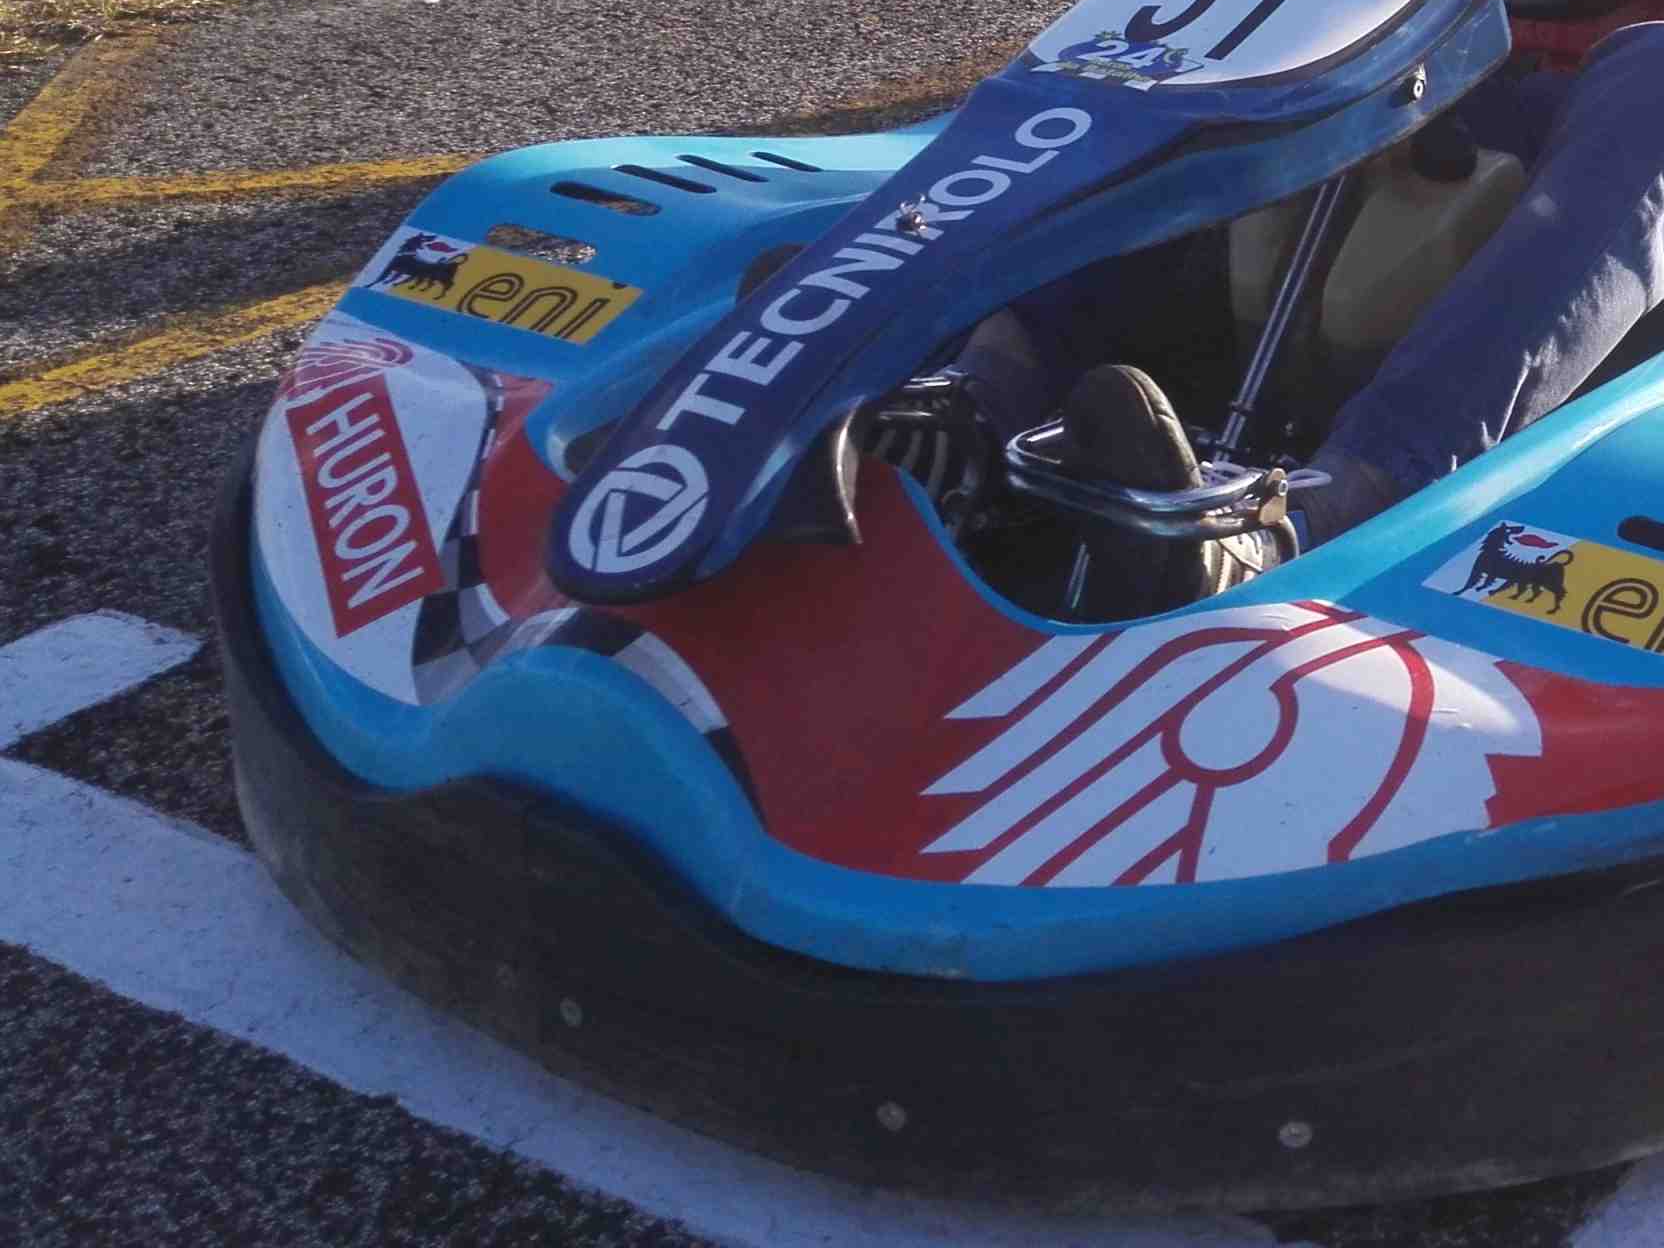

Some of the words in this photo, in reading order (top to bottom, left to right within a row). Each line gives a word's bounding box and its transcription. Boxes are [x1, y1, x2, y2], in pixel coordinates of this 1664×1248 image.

[457, 271, 628, 340] eni
[657, 106, 1092, 432] TECNIROLO
[306, 392, 426, 610] HURON
